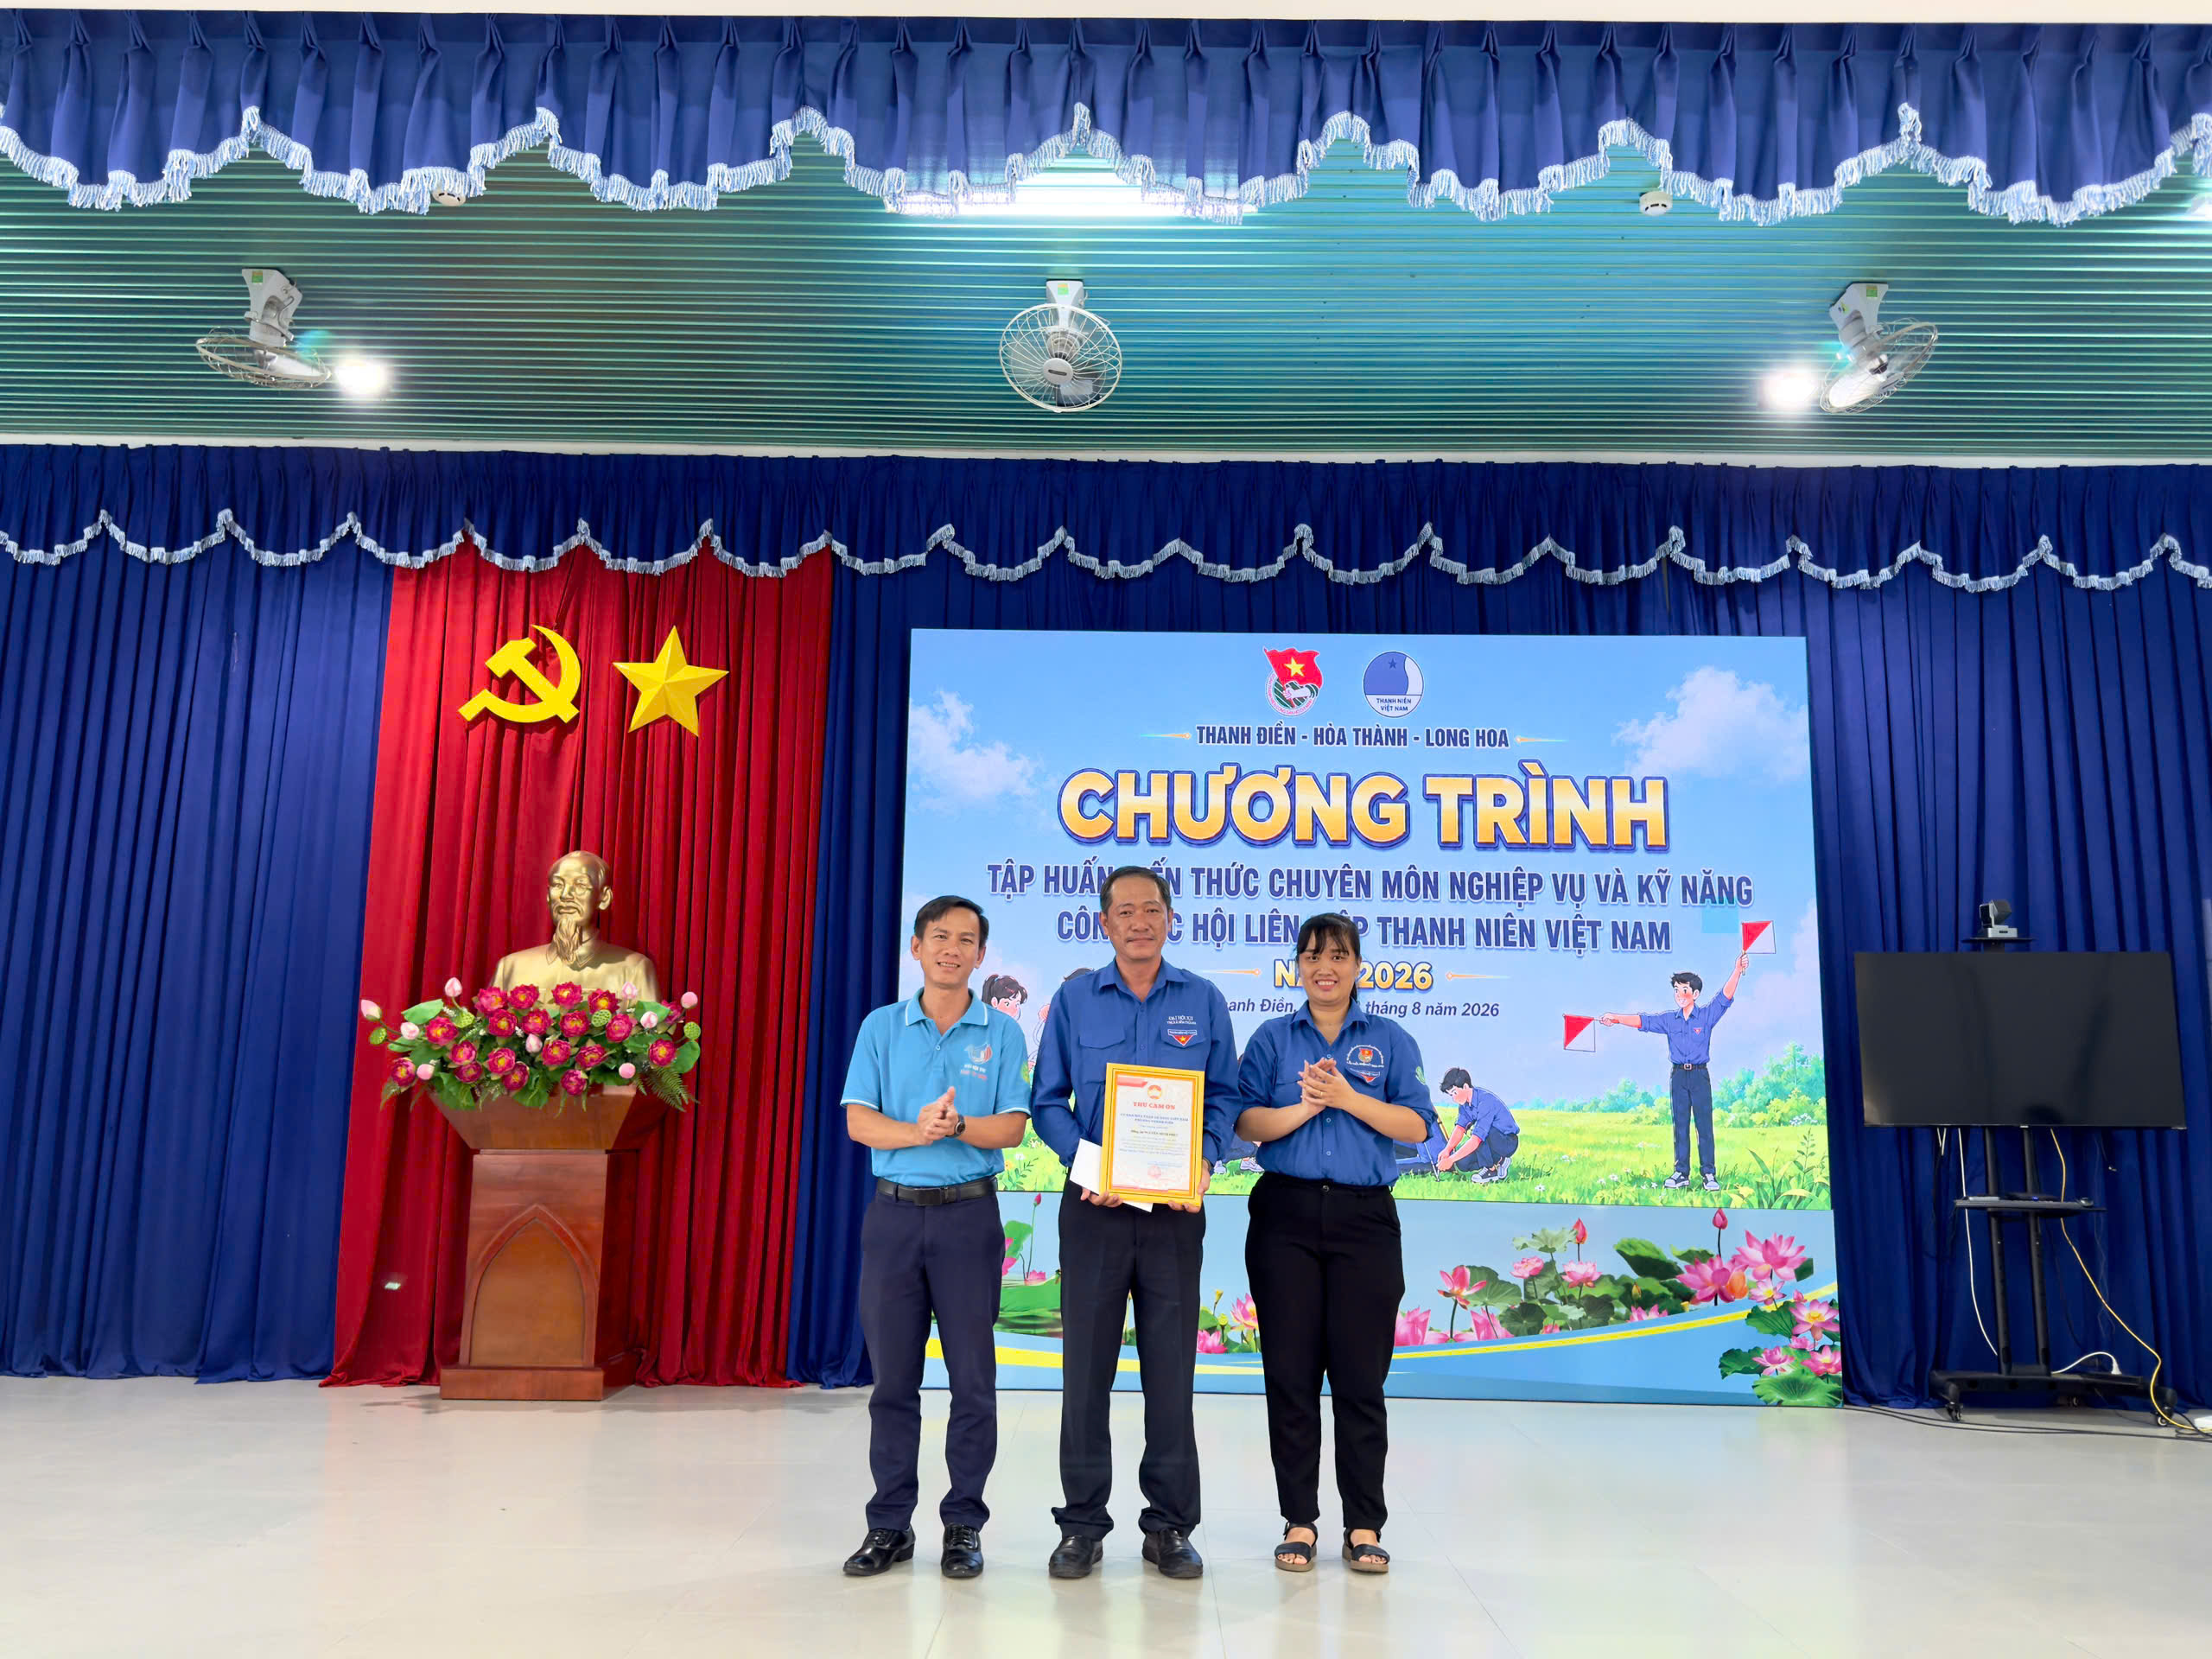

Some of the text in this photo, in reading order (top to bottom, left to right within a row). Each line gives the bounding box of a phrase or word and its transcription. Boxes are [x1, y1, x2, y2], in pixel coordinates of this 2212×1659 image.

[1196, 725, 1252, 745] THANH
[1255, 720, 1296, 746] ĐIỀN
[1313, 723, 1348, 747] HÒA
[1352, 723, 1408, 747] THÀNH
[1426, 728, 1471, 748] LONG
[1475, 728, 1510, 748] HOA
[1058, 760, 1670, 851] CHƯƠNG TRÌNH
[987, 858, 1035, 899] TẬP
[1044, 855, 1113, 894] HUẤN
[1191, 861, 1260, 898] THỨC
[1268, 863, 1371, 899] CHUYÊN
[1382, 865, 1440, 899] MÔN
[1450, 867, 1543, 908] NGHIỆP
[1553, 873, 1586, 910] VỤ
[1597, 868, 1630, 903] VÀ
[1638, 869, 1674, 905] KỸ
[1681, 869, 1753, 907] NĂNG
[1057, 905, 1109, 942] CÔN
[1192, 907, 1236, 949] HỘI
[1244, 908, 1300, 943] LIÊN
[1376, 916, 1466, 947] THANH
[1476, 912, 1536, 950] NIÊN
[1545, 914, 1603, 955] VIỆT
[1611, 920, 1671, 951] NAM
[1357, 960, 1434, 992] 2026
[1227, 997, 1255, 1013] anh
[1365, 1001, 1408, 1018] tháng
[1411, 1001, 1421, 1015] 8
[1425, 1001, 1457, 1017] năm
[1461, 1002, 1500, 1018] 2026
